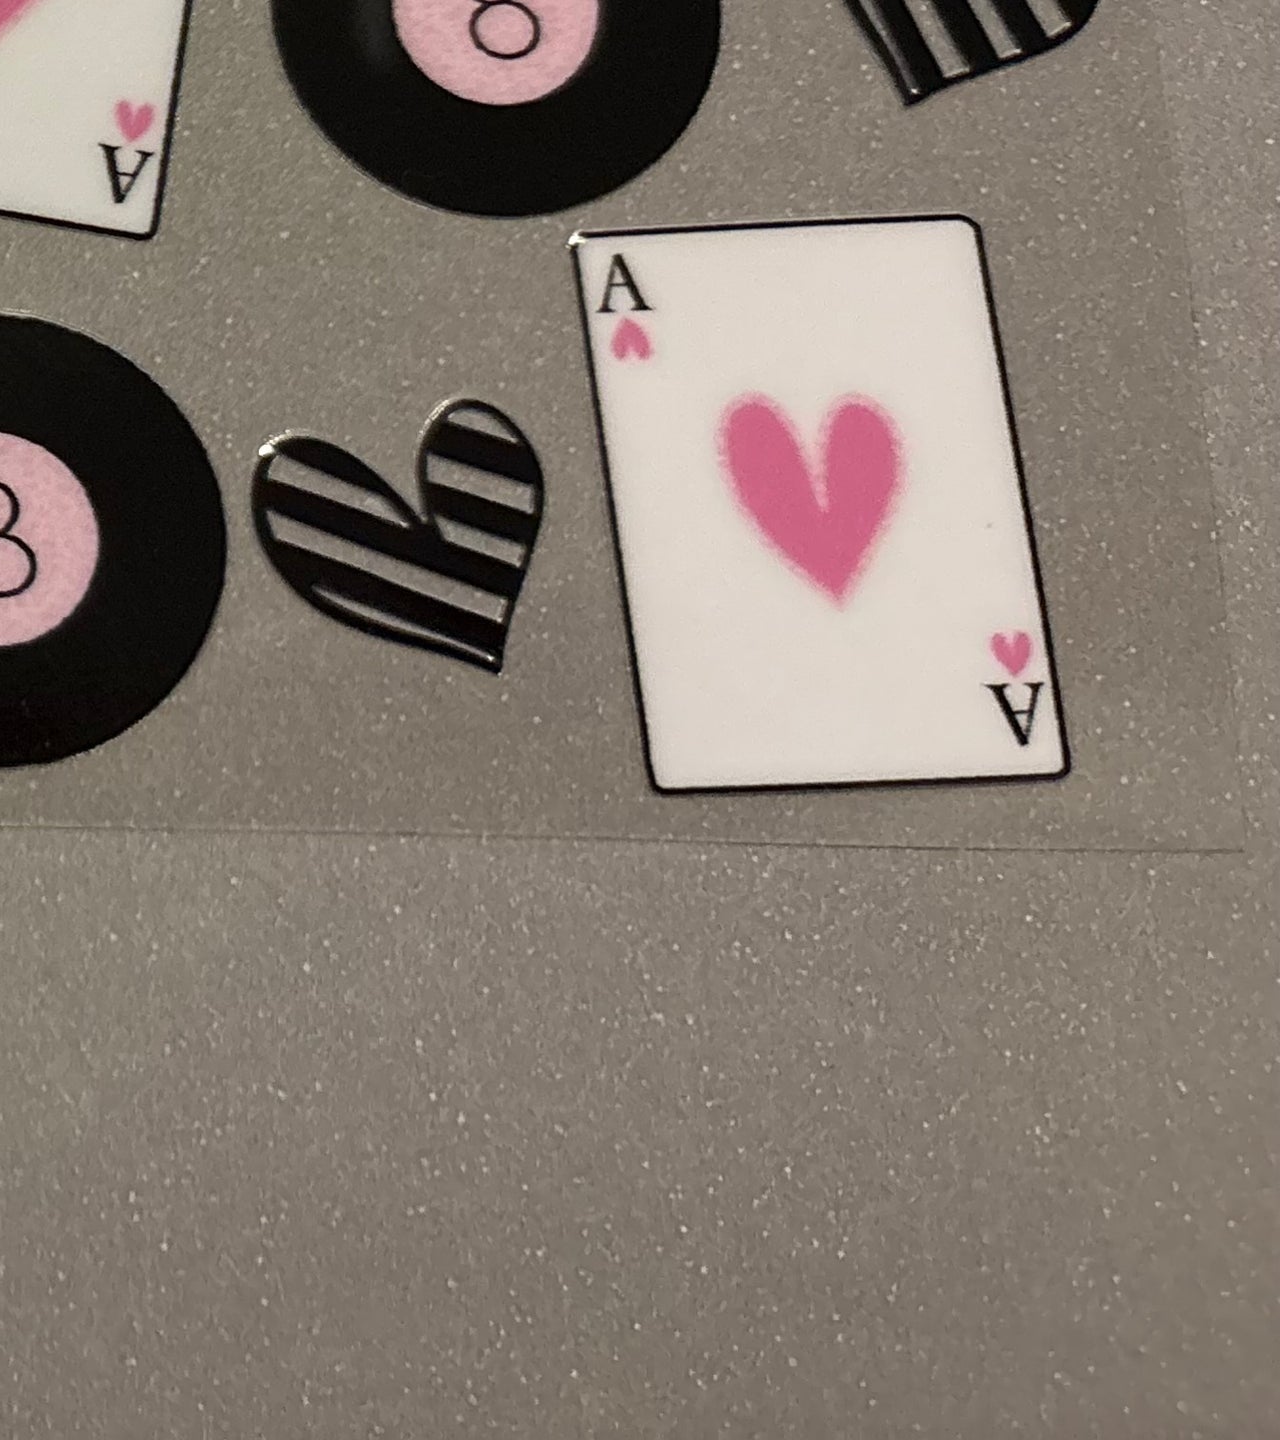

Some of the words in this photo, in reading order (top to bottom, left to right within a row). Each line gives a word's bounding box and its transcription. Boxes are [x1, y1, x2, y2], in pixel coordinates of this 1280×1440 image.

[99, 144, 154, 203] A
[598, 254, 652, 313] A
[987, 682, 1044, 746] A
